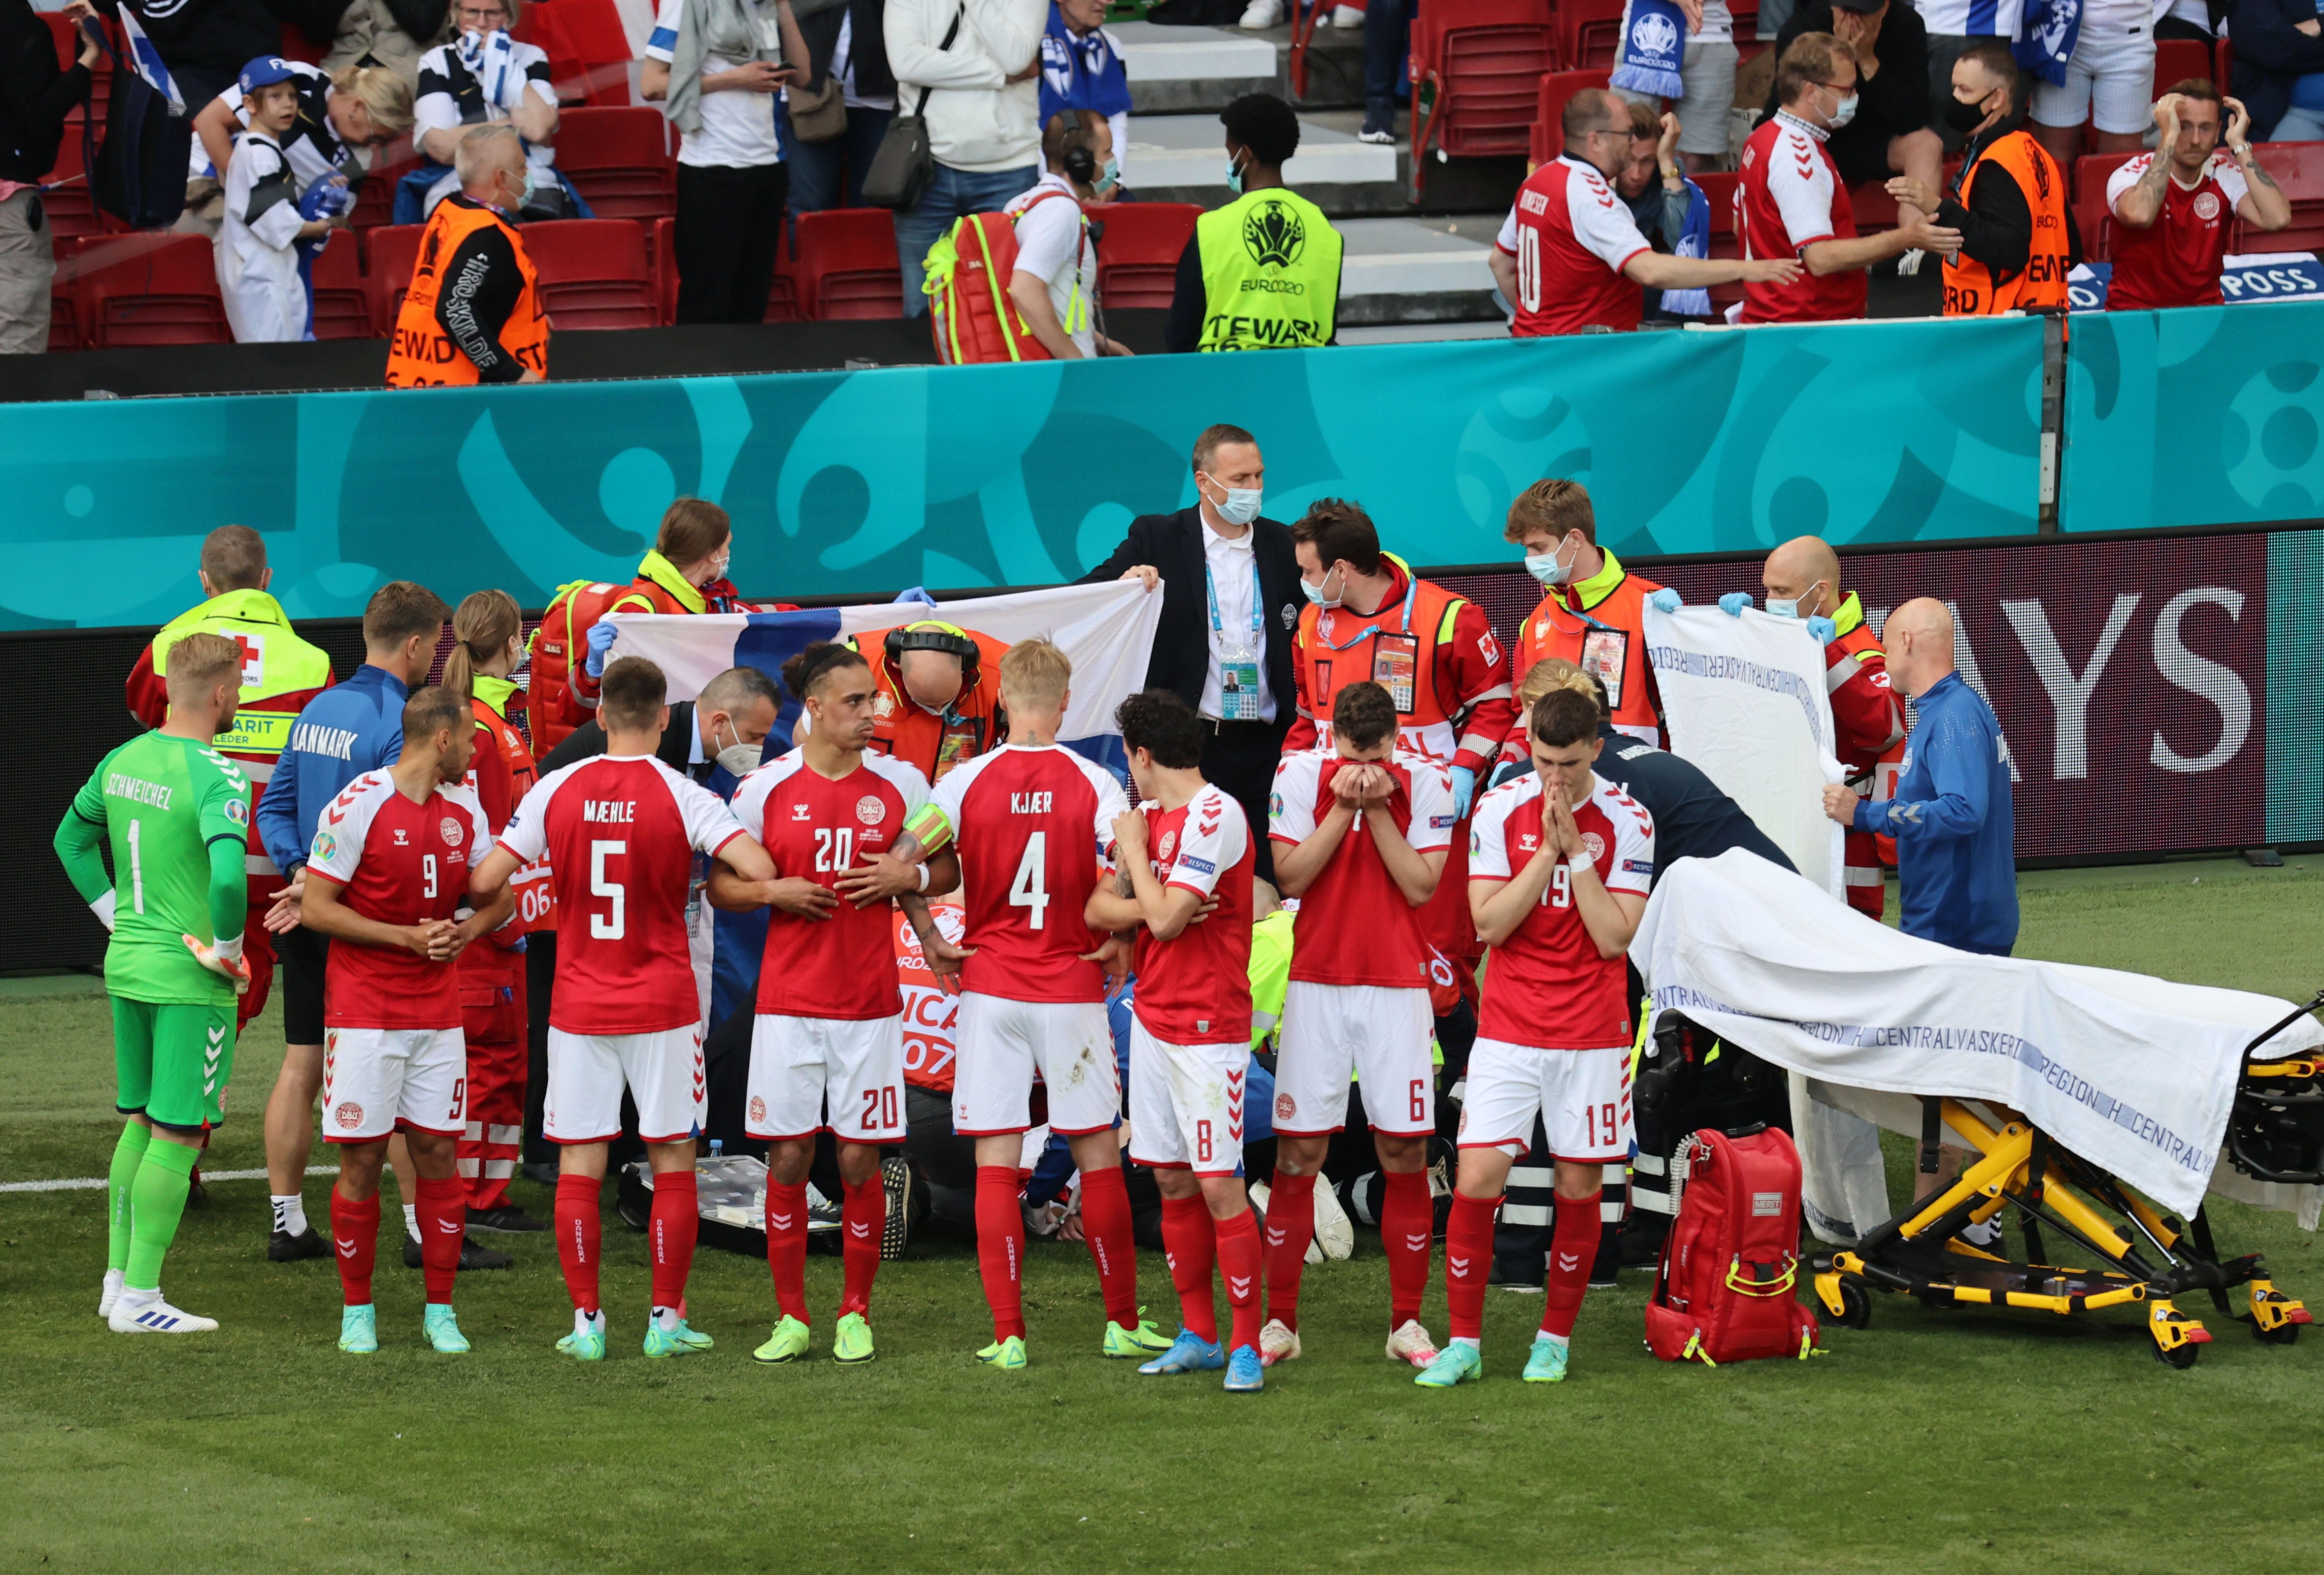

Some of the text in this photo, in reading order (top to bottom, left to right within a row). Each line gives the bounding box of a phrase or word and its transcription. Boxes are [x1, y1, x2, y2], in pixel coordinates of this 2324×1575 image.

[1628, 54, 1677, 71] EURO2020
[1517, 223, 1541, 314] 10
[214, 734, 248, 744] LEDER
[105, 773, 172, 811] SCHMEICHEL
[584, 799, 636, 823] MÆHLE
[863, 806, 878, 814] DBU
[1011, 791, 1052, 814] KJÆR
[127, 819, 144, 915] 1
[814, 827, 853, 872] 20
[1189, 858, 1214, 872] RESPECT
[423, 853, 437, 898] 9
[591, 840, 626, 940] 5
[1009, 831, 1050, 929] 4
[1852, 1026, 1865, 1046] H
[1875, 1026, 2024, 1059] CENTRALVASKERI
[2039, 1054, 2100, 1109] REGION
[2107, 1099, 2123, 1122] H
[341, 1111, 358, 1120] DBU
[449, 1078, 465, 1119] 9
[861, 1085, 897, 1130] 20
[1279, 1102, 1292, 1111] DBU
[1410, 1079, 1425, 1122] 6
[1197, 1119, 1212, 1162] 8
[1586, 1103, 1617, 1148] 19
[1755, 1200, 1780, 1209] MERET
[575, 1219, 586, 1263] DANMARK
[657, 1219, 665, 1264] DANMARK
[1006, 1236, 1016, 1281] DANMARK
[1095, 1237, 1109, 1276] DANMARK
